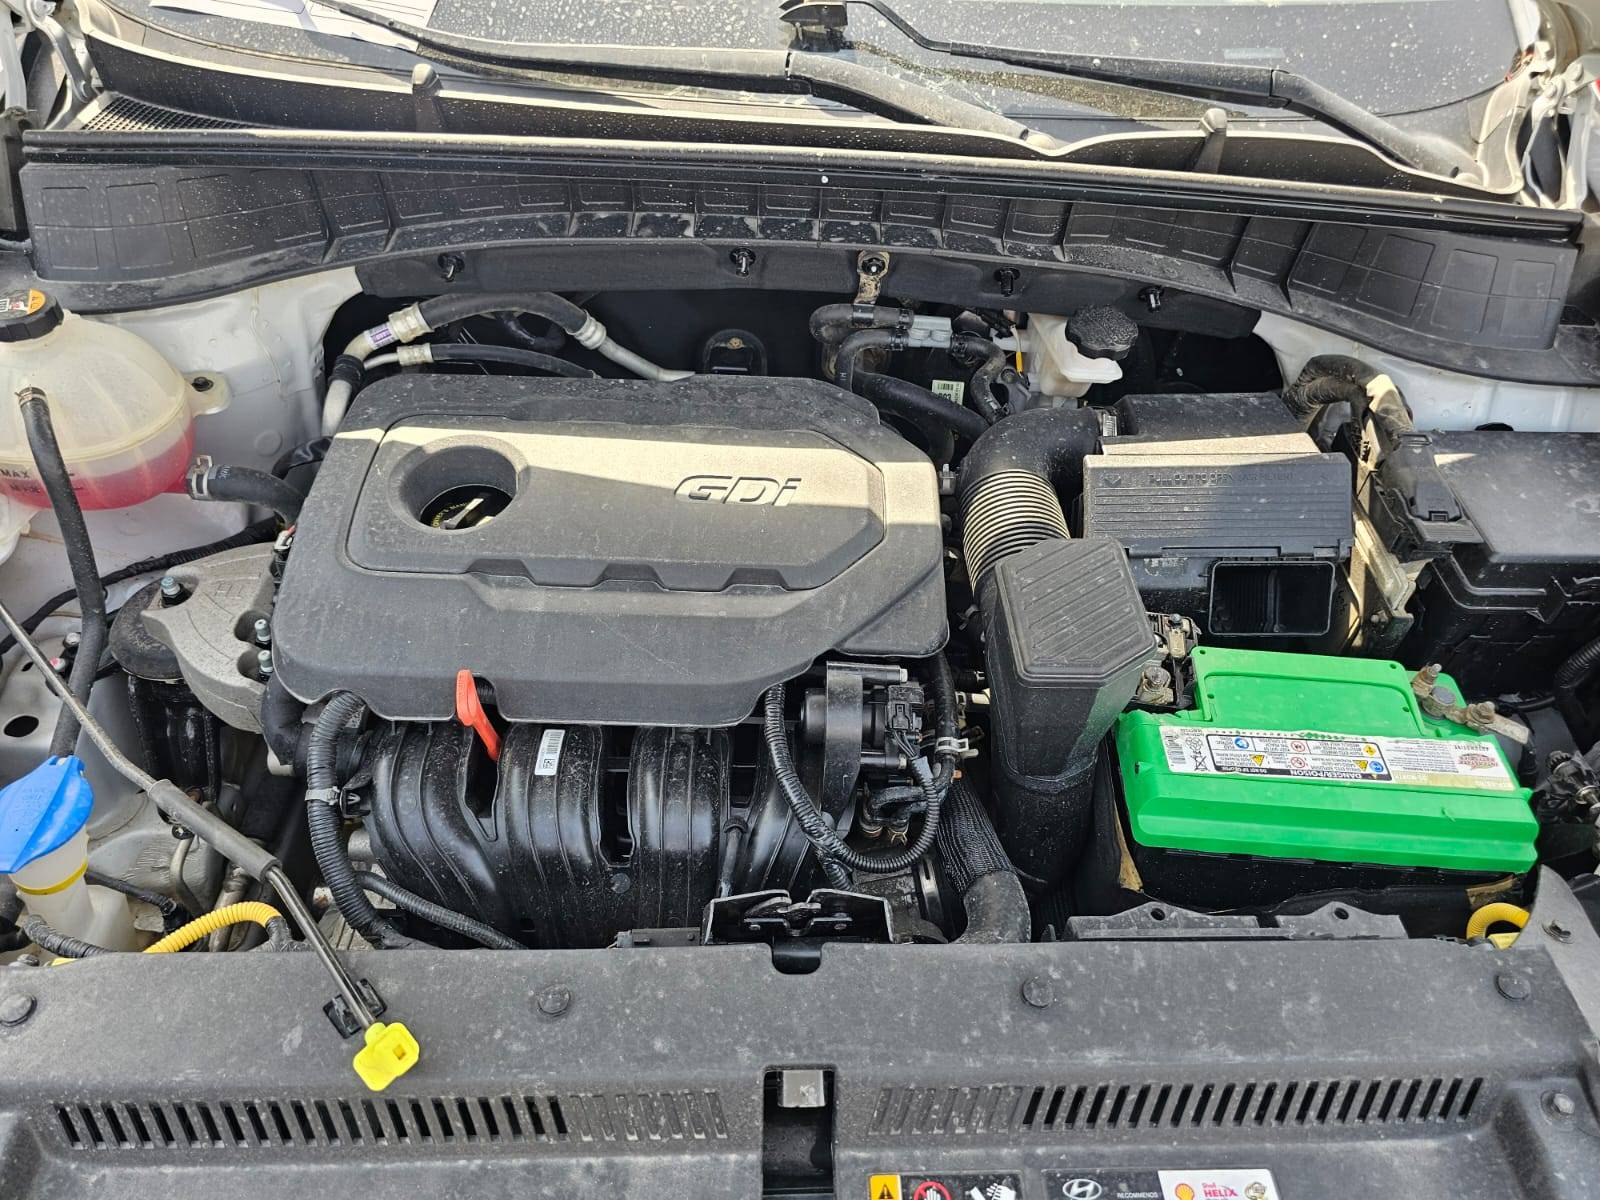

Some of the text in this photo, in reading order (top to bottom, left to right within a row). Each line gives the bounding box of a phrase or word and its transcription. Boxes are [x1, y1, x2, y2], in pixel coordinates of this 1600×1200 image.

[0, 468, 30, 478] MAX
[674, 475, 802, 506] GDi
[1204, 1189, 1238, 1198] HELIX
